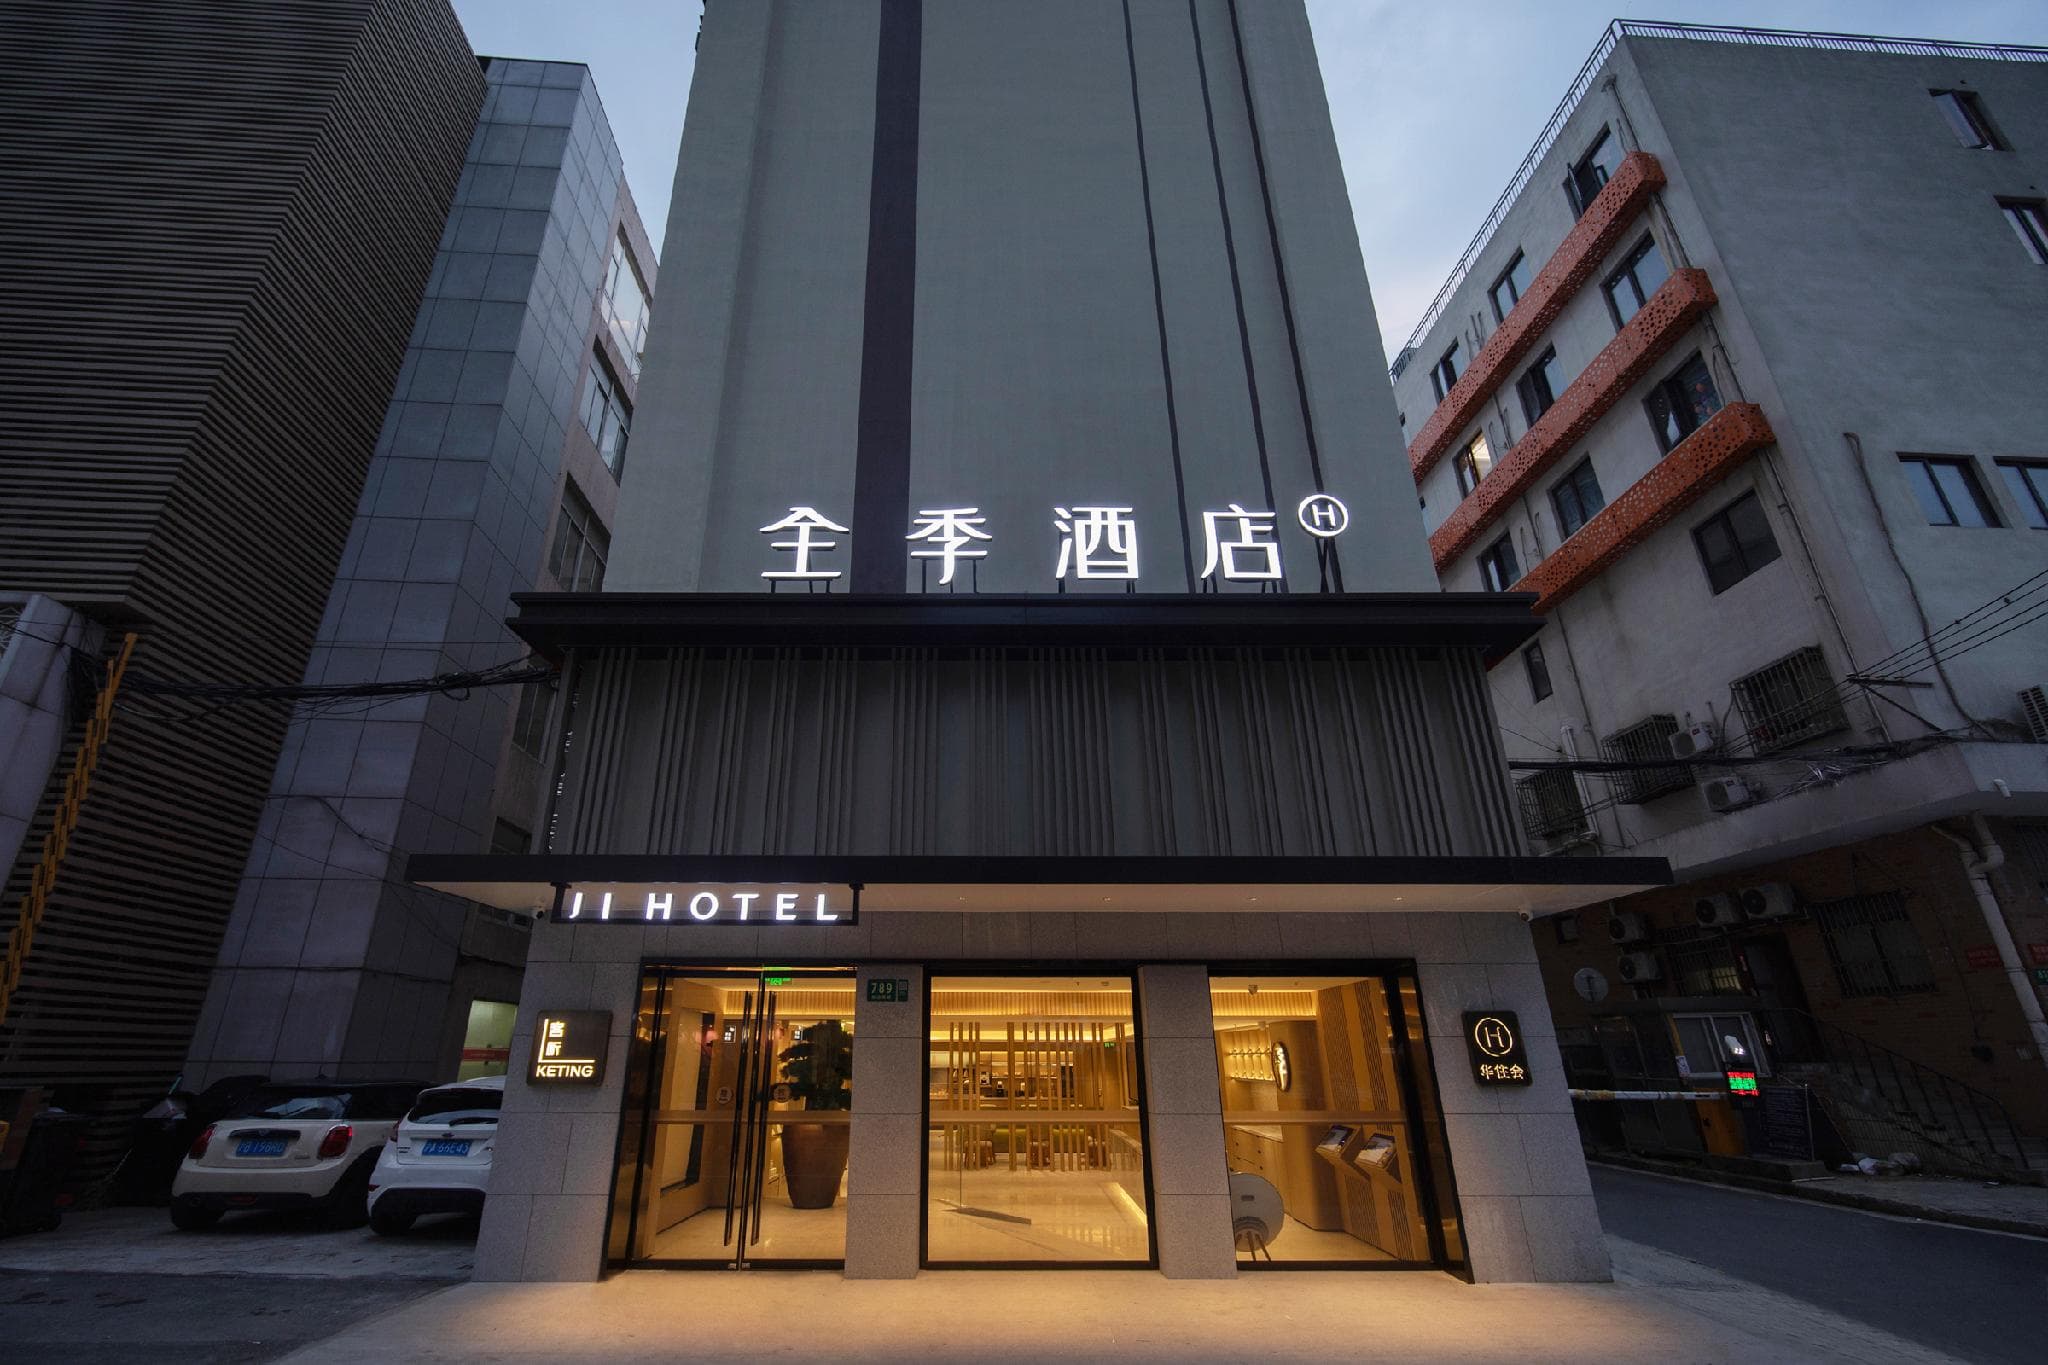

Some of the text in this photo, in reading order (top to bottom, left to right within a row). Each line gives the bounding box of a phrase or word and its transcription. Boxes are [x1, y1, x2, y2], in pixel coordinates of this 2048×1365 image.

[760, 503, 1283, 585] 全季酒店
[568, 891, 839, 921] JI HOTEL
[871, 982, 893, 994] 789
[535, 1064, 594, 1078] KETING
[1480, 1063, 1525, 1080] 华住会
